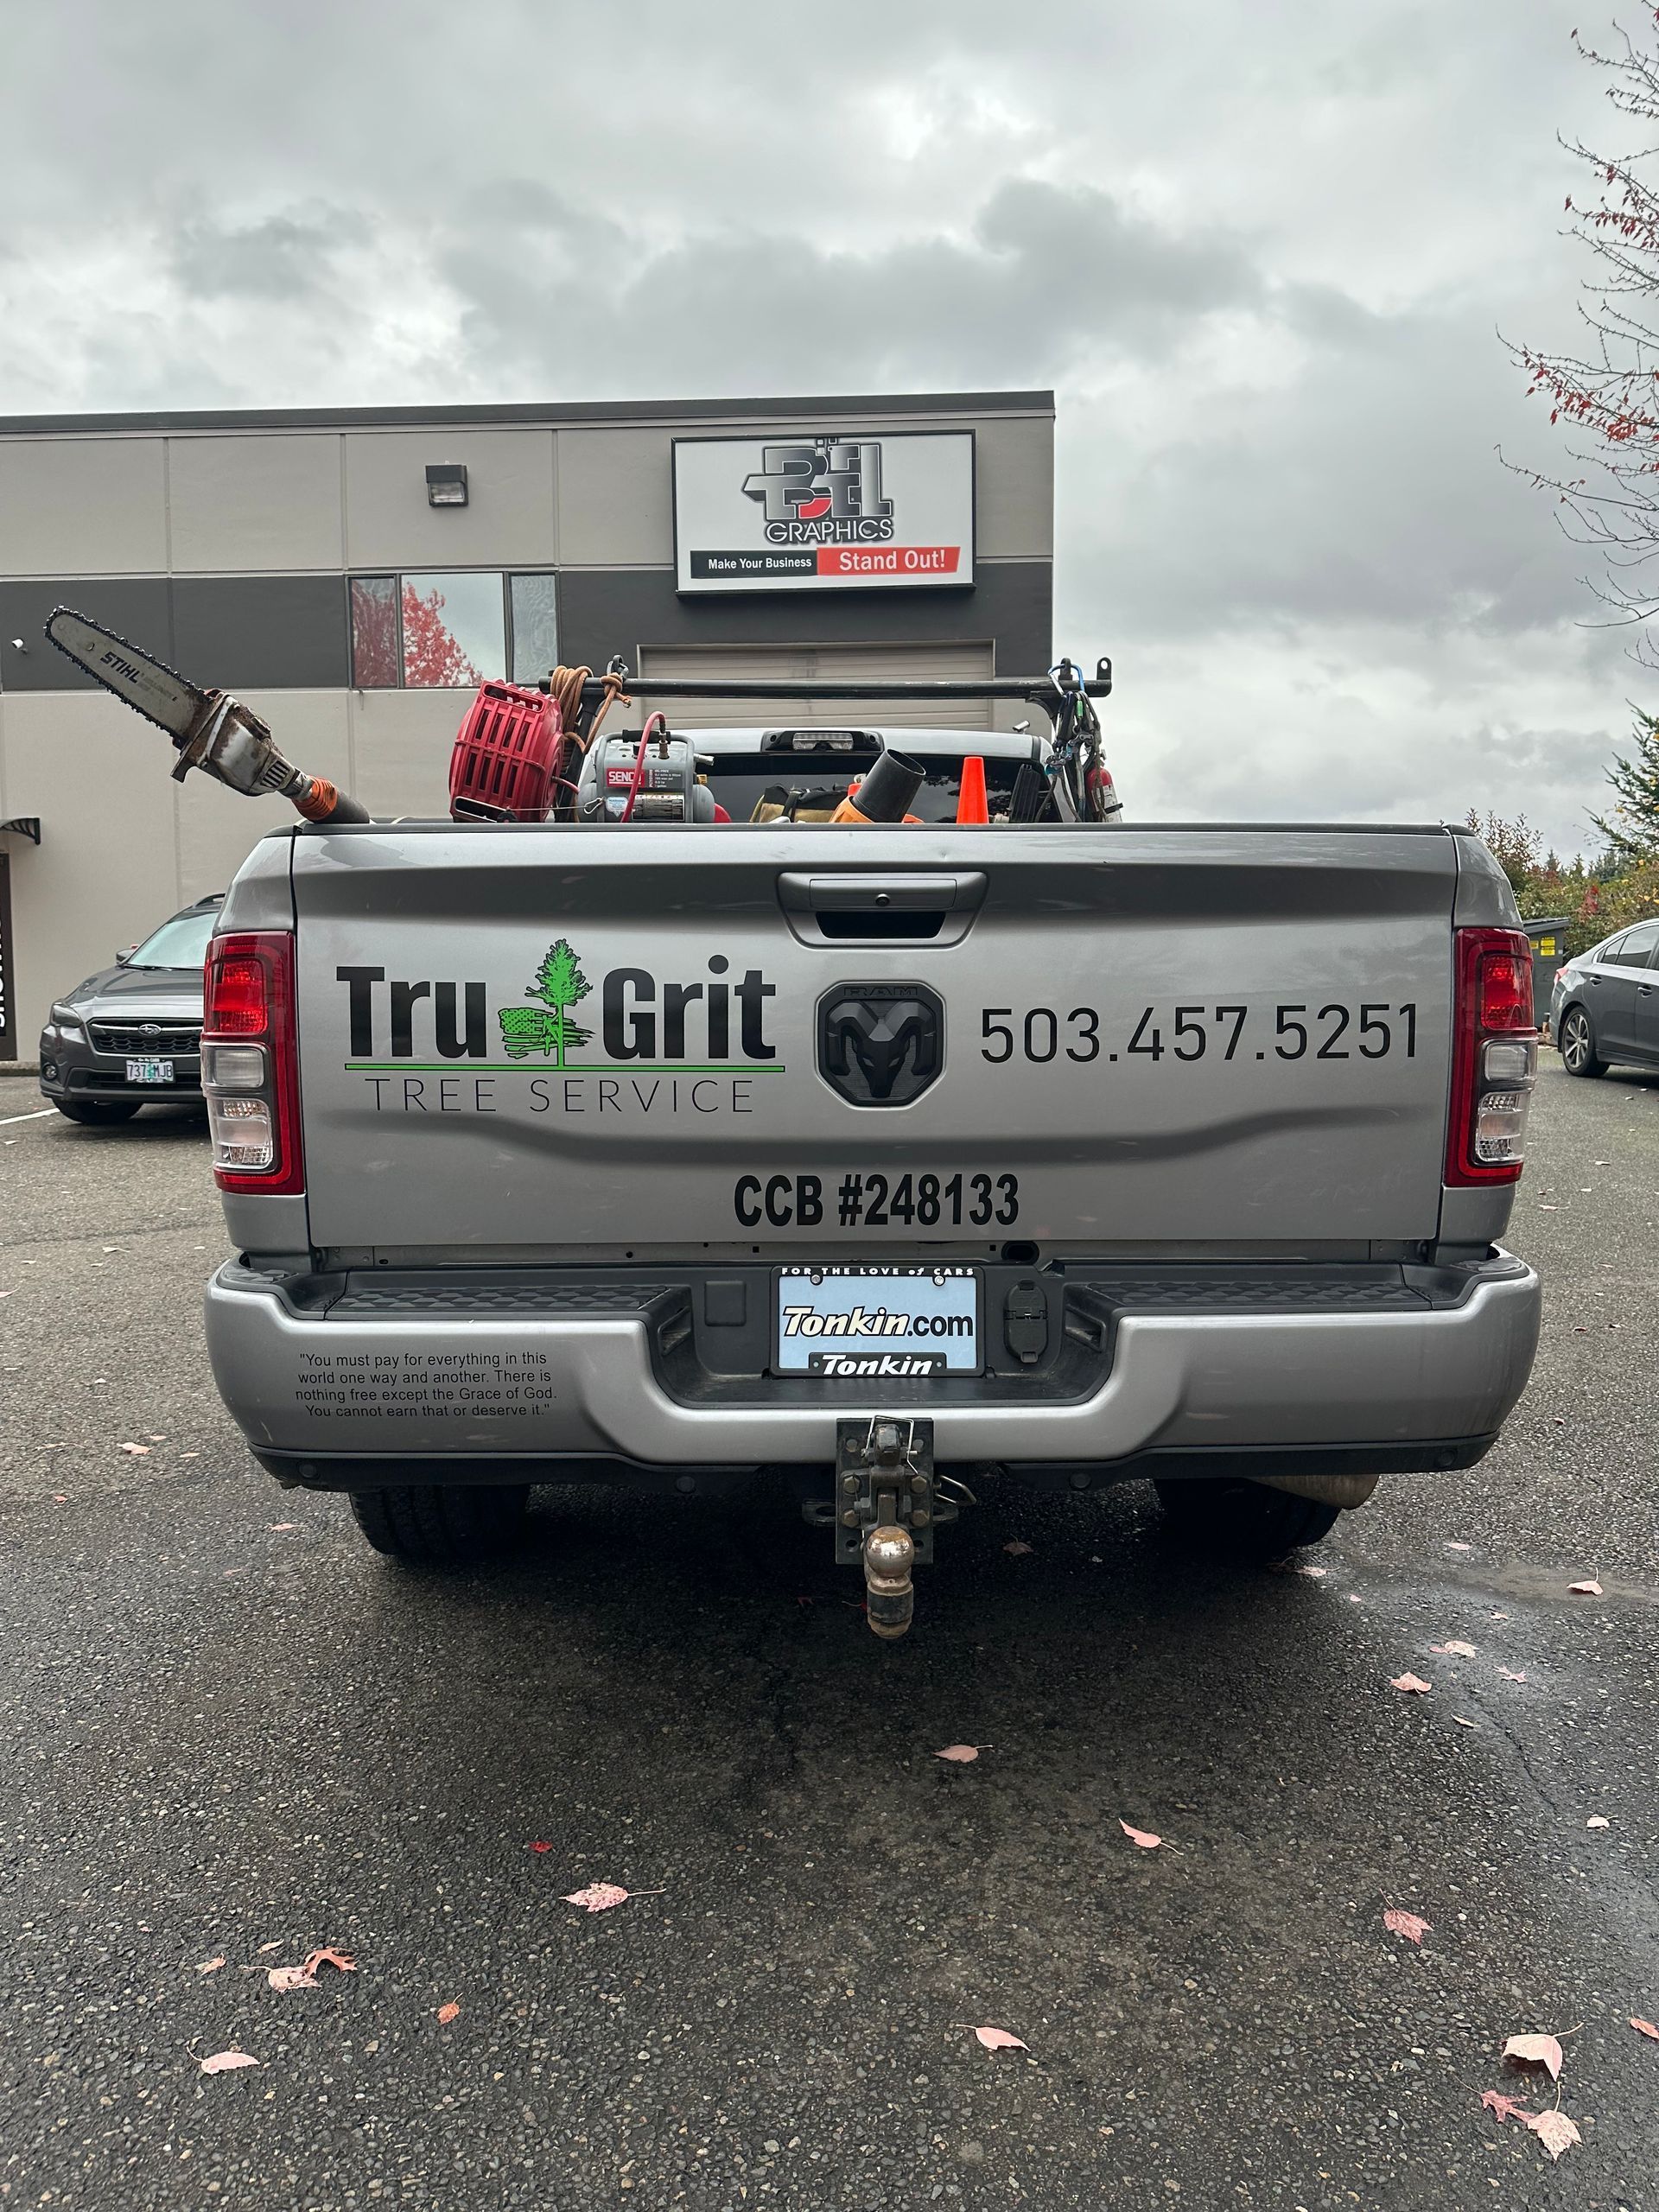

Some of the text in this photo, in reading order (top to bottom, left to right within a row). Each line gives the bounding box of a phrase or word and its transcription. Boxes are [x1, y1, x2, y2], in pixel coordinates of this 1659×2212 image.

[765, 518, 893, 543] GRAPHICS
[708, 549, 946, 571] Make Your Business Stand Out!
[99, 651, 141, 684] STIHL
[608, 771, 641, 782] SENC
[843, 987, 918, 996] RAM
[336, 955, 776, 1059] Tru Grit
[981, 1003, 1417, 1063] 503.457.5251
[127, 1064, 146, 1077] 737
[365, 1078, 753, 1113] TREE SERVICE
[734, 1173, 1020, 1227] CCB #248133
[783, 1306, 974, 1338] Tonkin.com
[300, 1351, 547, 1369] "You must pay for everything in this
[822, 1354, 932, 1376] Tonkin
[297, 1369, 551, 1387] world one way and another. There is
[296, 1386, 557, 1403] nothing free except the Grace of God.
[305, 1404, 331, 1417] You
[335, 1406, 382, 1417] cannot
[386, 1407, 417, 1417] earn
[422, 1405, 448, 1417] that
[453, 1407, 467, 1416] or
[472, 1405, 526, 1416] deserve
